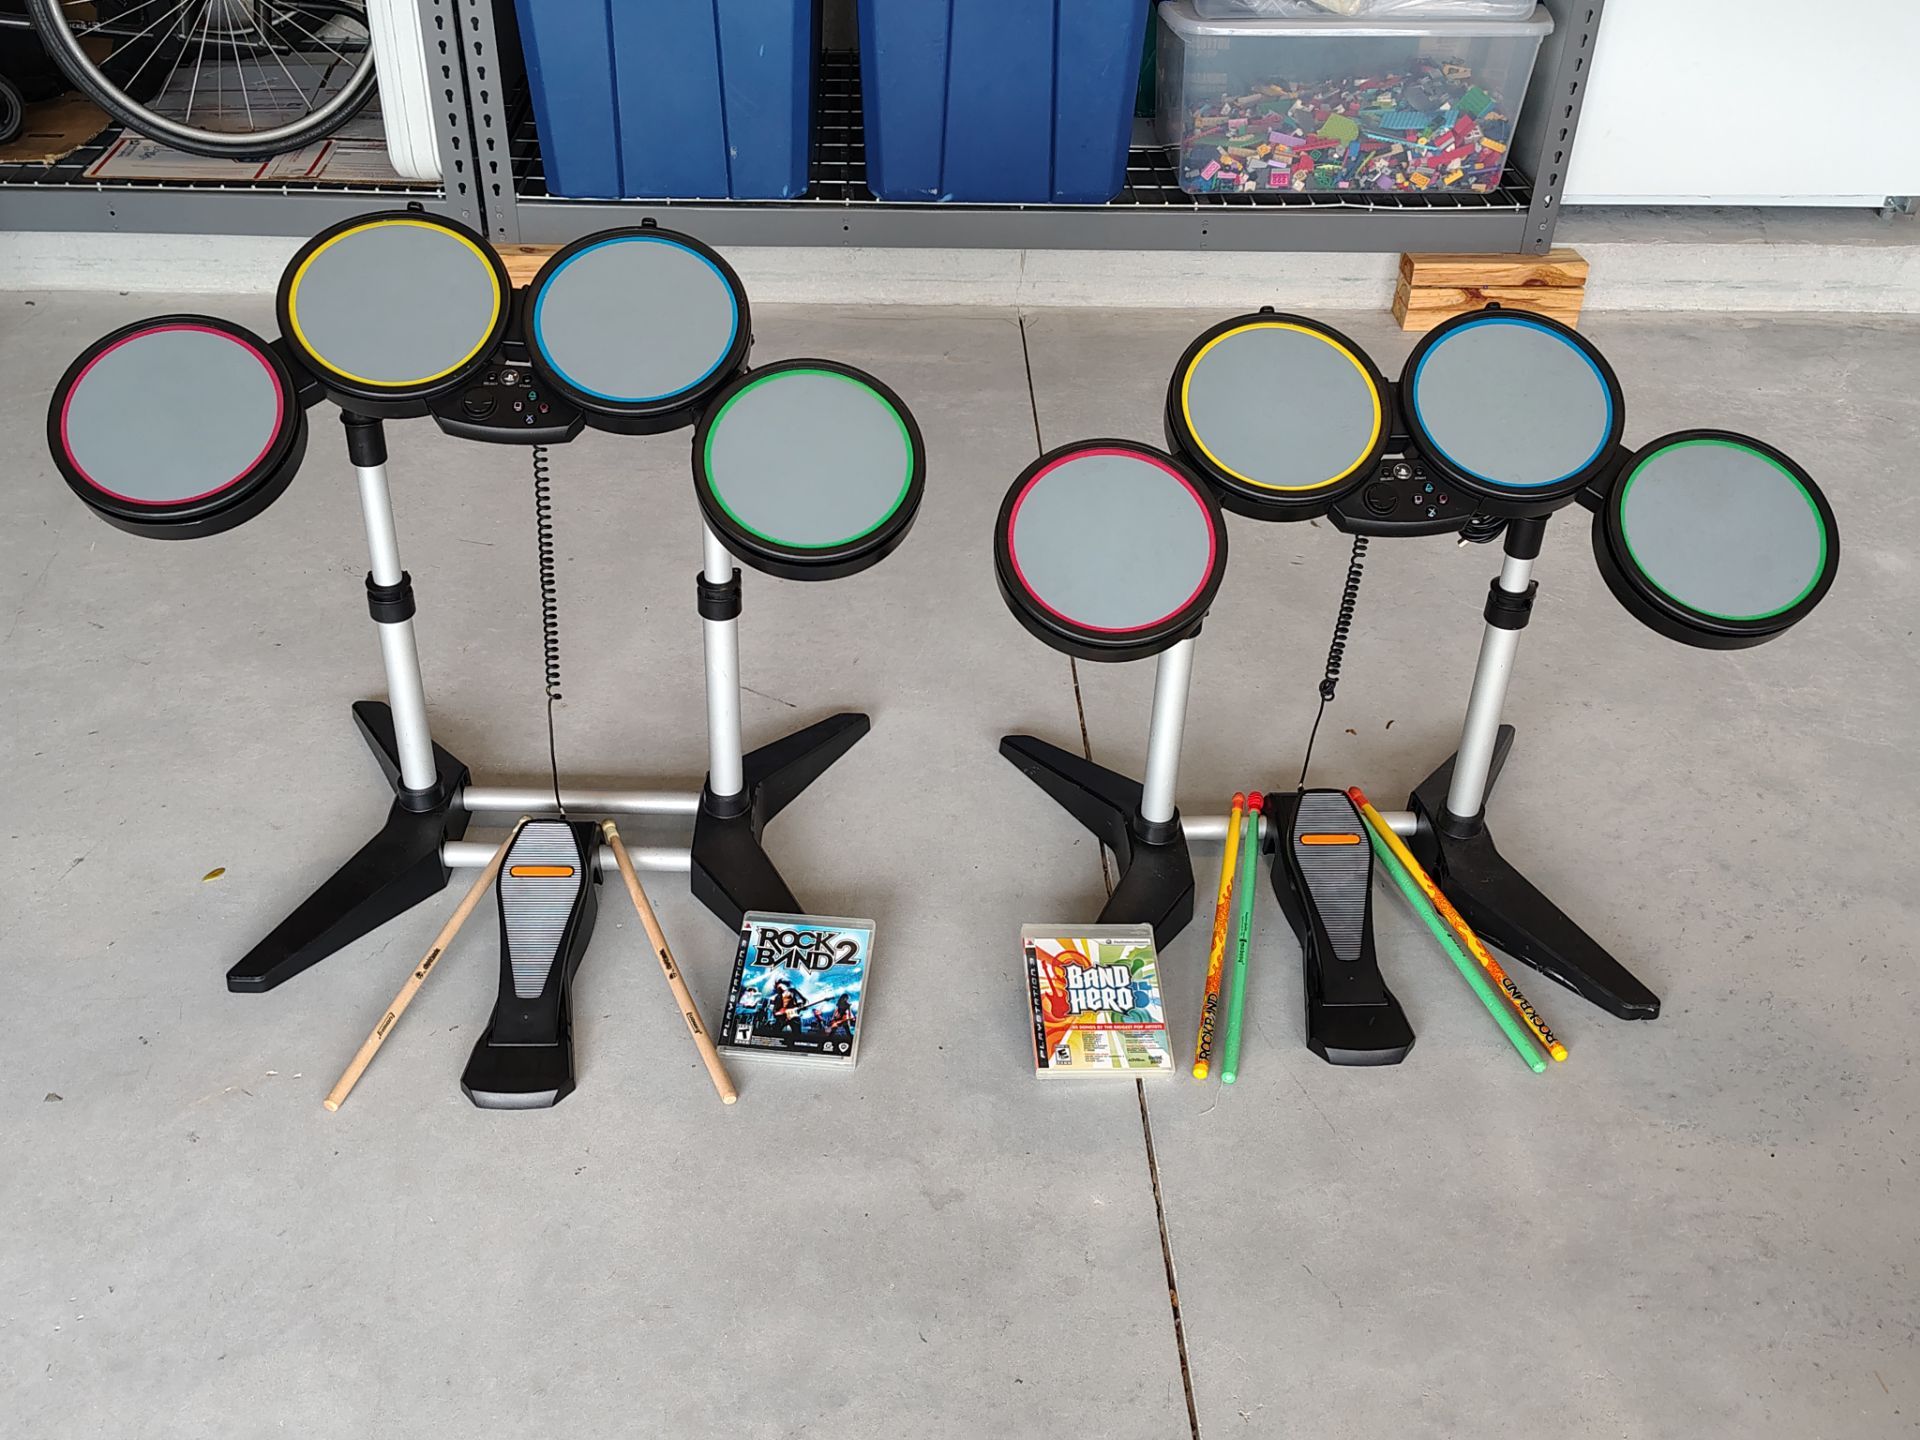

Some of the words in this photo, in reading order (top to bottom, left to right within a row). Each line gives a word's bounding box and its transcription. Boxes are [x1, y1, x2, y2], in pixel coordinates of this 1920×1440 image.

[757, 926, 840, 956] ROCK
[752, 946, 834, 974] BAND
[835, 939, 861, 965] 2
[1065, 964, 1131, 989] BAND
[1068, 986, 1135, 1015] HERO
[738, 1028, 750, 1040] T
[1056, 1048, 1070, 1060] E
